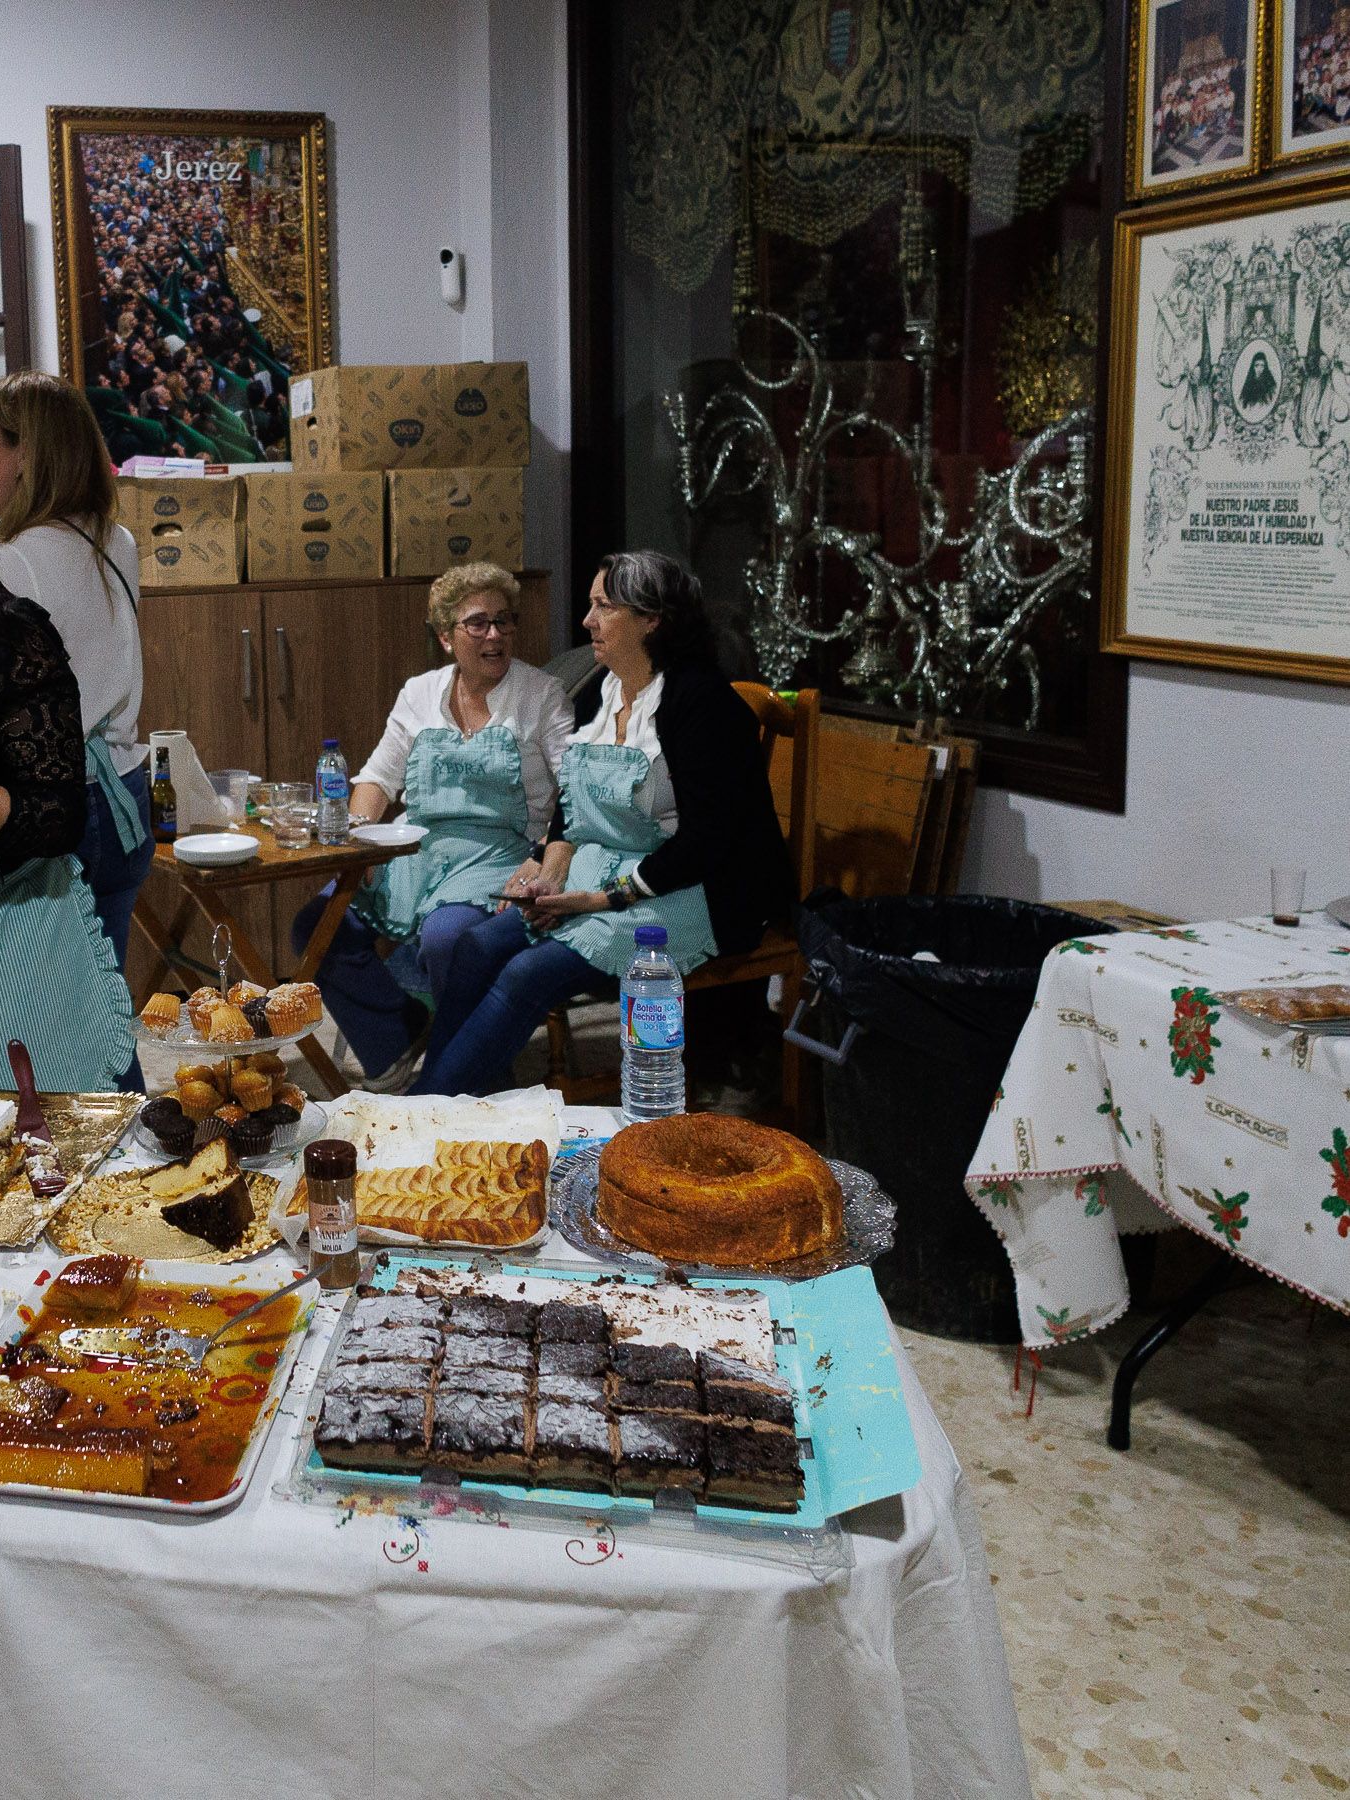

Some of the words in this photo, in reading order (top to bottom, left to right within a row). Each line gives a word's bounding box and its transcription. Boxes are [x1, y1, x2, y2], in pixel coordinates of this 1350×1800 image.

[155, 151, 242, 181] Jerez
[393, 425, 421, 436] okin
[1206, 498, 1241, 511] NUESTRO
[1243, 498, 1270, 512] PADRE
[1190, 514, 1200, 527] DE
[1201, 514, 1210, 527] LA
[1212, 514, 1255, 528] SENTENCIA
[1258, 515, 1264, 528] Y
[1266, 515, 1308, 529] HUMILDAD
[1310, 516, 1317, 529] Y
[1180, 529, 1214, 542] NUESTRA
[1250, 531, 1261, 544] DE
[1262, 531, 1272, 545] LA
[1275, 531, 1323, 546] ESPERANZA
[637, 1004, 662, 1012] Botella
[632, 1012, 655, 1021] hecha
[656, 1013, 667, 1021] de
[321, 1244, 343, 1252] MOLIDA
